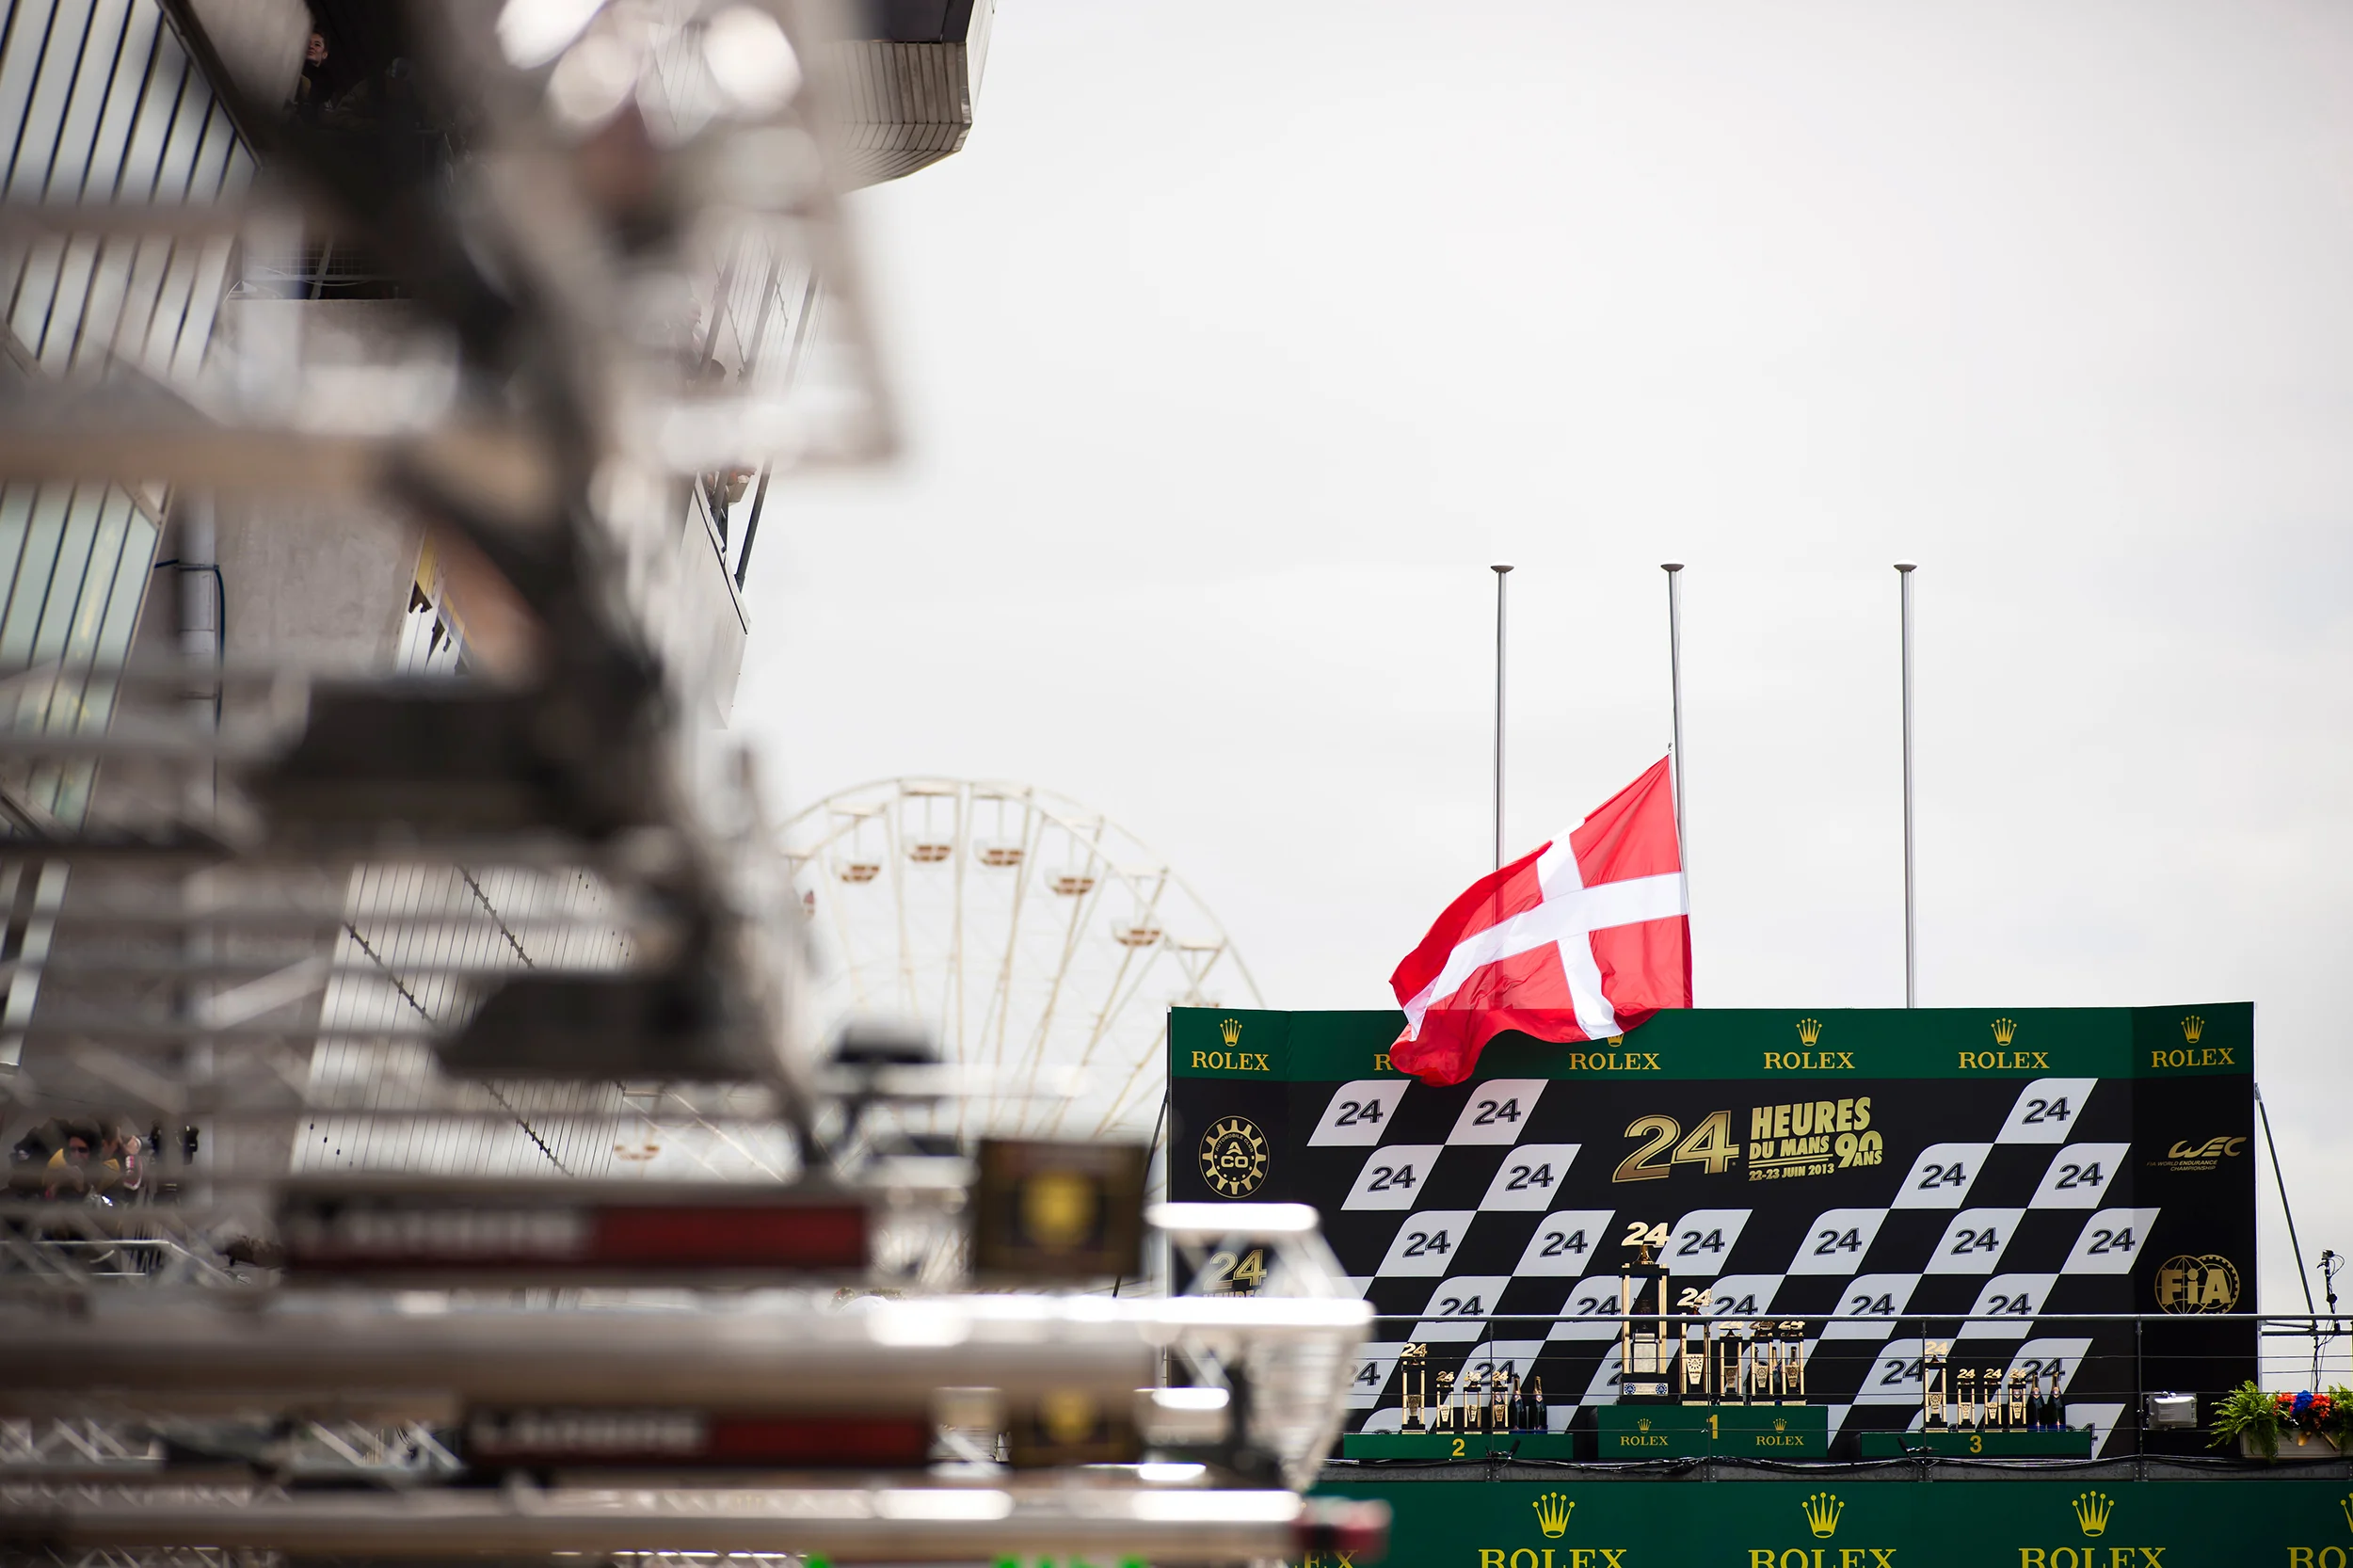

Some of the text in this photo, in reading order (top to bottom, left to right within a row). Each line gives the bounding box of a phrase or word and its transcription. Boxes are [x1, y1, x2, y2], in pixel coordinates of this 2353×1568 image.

[1191, 1050, 1270, 1072] ROLEX
[1568, 1052, 1661, 1071] ROLEX
[1763, 1051, 1855, 1070] ROLEX
[1958, 1051, 2050, 1069] ROLEX
[2152, 1048, 2235, 1068] ROLEX
[1335, 1099, 1384, 1128] 24
[1472, 1097, 1522, 1127] 24
[1751, 1096, 1871, 1140] HEURES
[2022, 1096, 2071, 1125] 24
[1215, 1133, 1254, 1153] AUTOMOBILE CLUB
[1611, 1110, 1739, 1183] 24
[1749, 1135, 1830, 1160] DU MANS
[1834, 1130, 1882, 1168] 90
[2168, 1136, 2248, 1159] WEC
[1852, 1150, 1882, 1167] ANS
[1368, 1163, 1417, 1192] 24
[1505, 1162, 1554, 1192] 24
[1748, 1162, 1835, 1182] 22-23 JUIN 2013
[1917, 1161, 1966, 1191] 24
[2055, 1161, 2104, 1191] 24
[1402, 1229, 1451, 1257] 24
[1540, 1229, 1588, 1257] 24
[1621, 1222, 1670, 1248] 24
[1676, 1228, 1725, 1256] 24
[1814, 1227, 1863, 1256] 24
[1950, 1226, 1999, 1256] 24
[2087, 1226, 2136, 1256] 24
[1204, 1249, 1268, 1289] 24
[1440, 1295, 1484, 1316] 24
[1577, 1295, 1622, 1316] 24
[1676, 1287, 1713, 1307] 24
[1713, 1293, 1758, 1316] 24
[1850, 1292, 1896, 1316] 24
[1987, 1292, 2032, 1316] 24
[1401, 1343, 1428, 1357] 24
[1925, 1341, 1948, 1355] 24
[1436, 1370, 1454, 1383] 24
[1474, 1359, 1517, 1386] 24
[1492, 1370, 1509, 1383] 24
[1880, 1357, 1924, 1386] 24
[1957, 1368, 1976, 1380] 24
[1983, 1368, 2002, 1380] 24
[2022, 1358, 2066, 1385] 24
[1706, 1414, 1719, 1440] 1
[1451, 1437, 1465, 1457] 2
[1620, 1435, 1669, 1446] ROLEX
[1755, 1435, 1805, 1446] ROLEX
[1969, 1435, 1983, 1453] 3
[1478, 1548, 1627, 1568] ROLEX
[1748, 1548, 1897, 1568] ROLEX
[2018, 1546, 2167, 1568] ROLEX
[2286, 1546, 2353, 1568] RO
